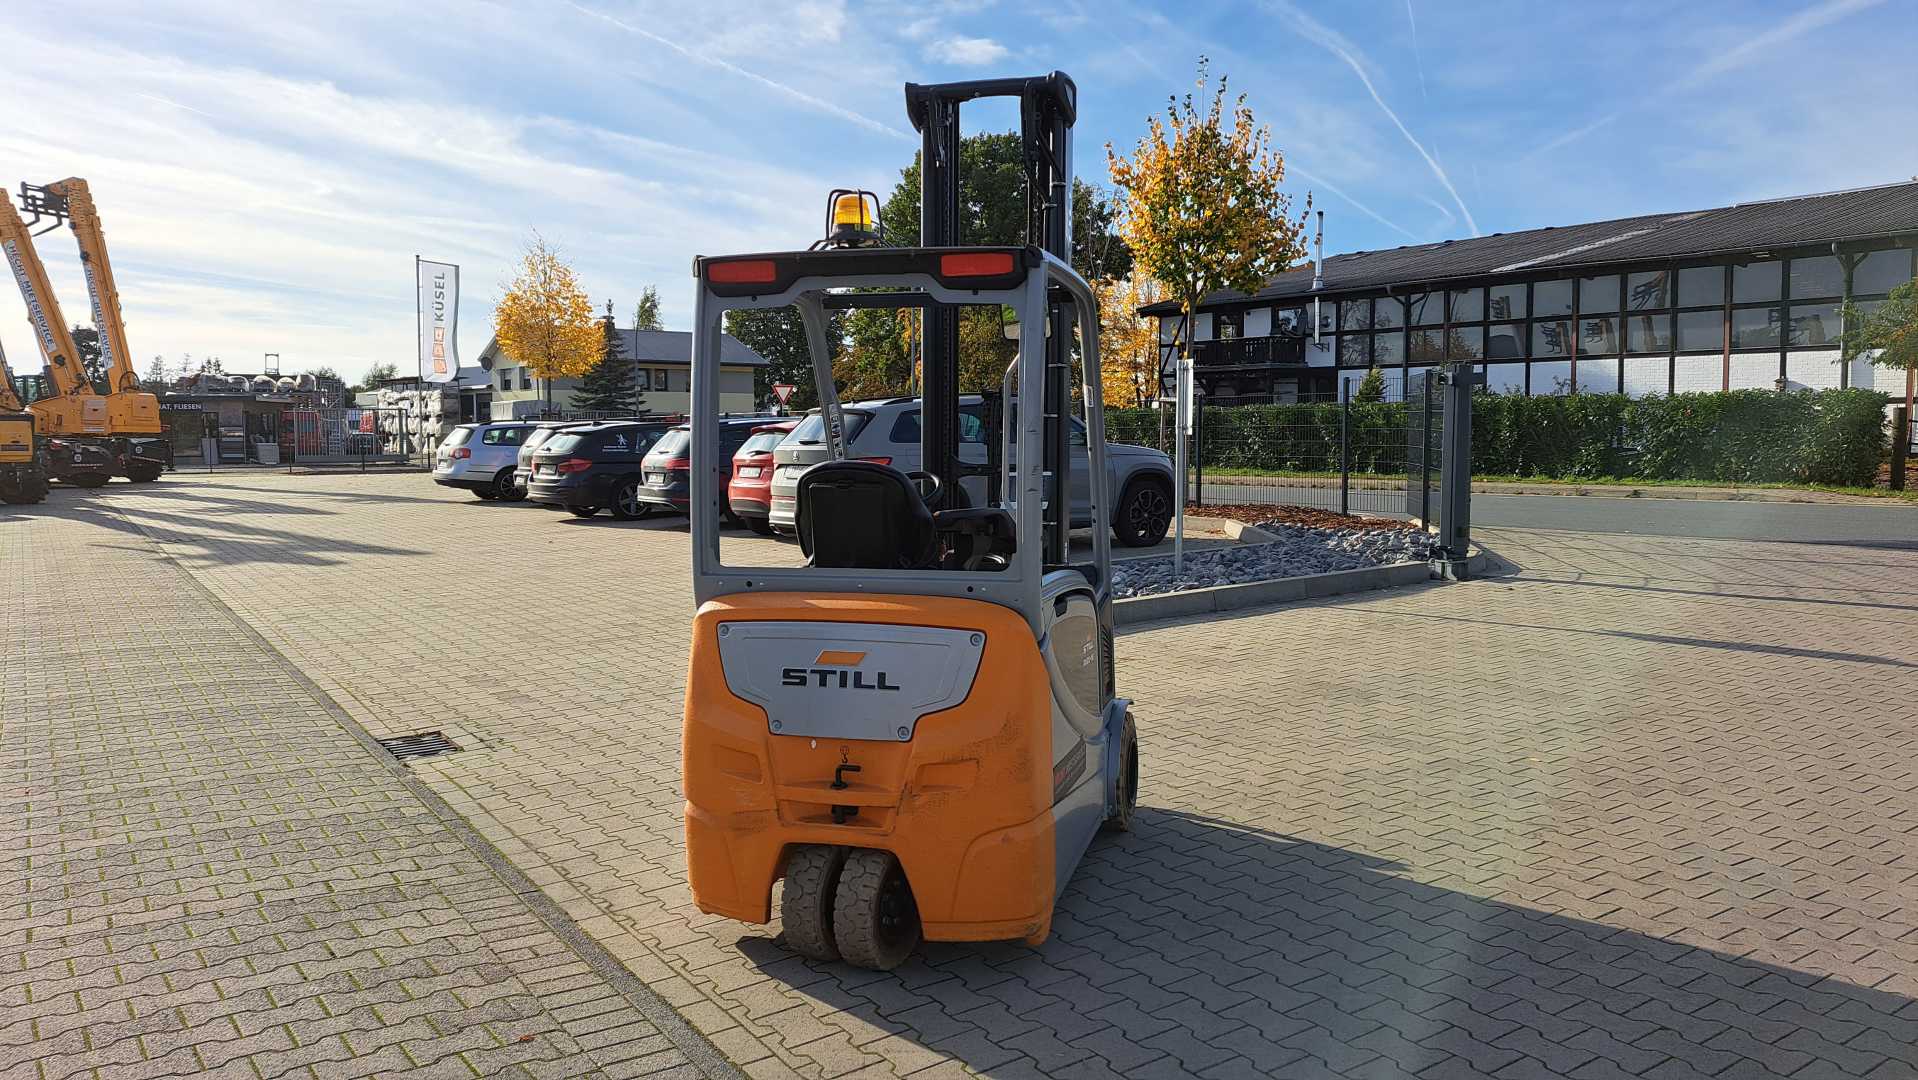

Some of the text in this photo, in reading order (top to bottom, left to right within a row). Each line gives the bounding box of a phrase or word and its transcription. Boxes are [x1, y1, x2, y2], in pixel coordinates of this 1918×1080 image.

[9, 246, 25, 276] HECHT
[24, 280, 53, 345] MIETSERVICE
[432, 272, 445, 321] KÜSEL
[782, 668, 900, 691] STILL
